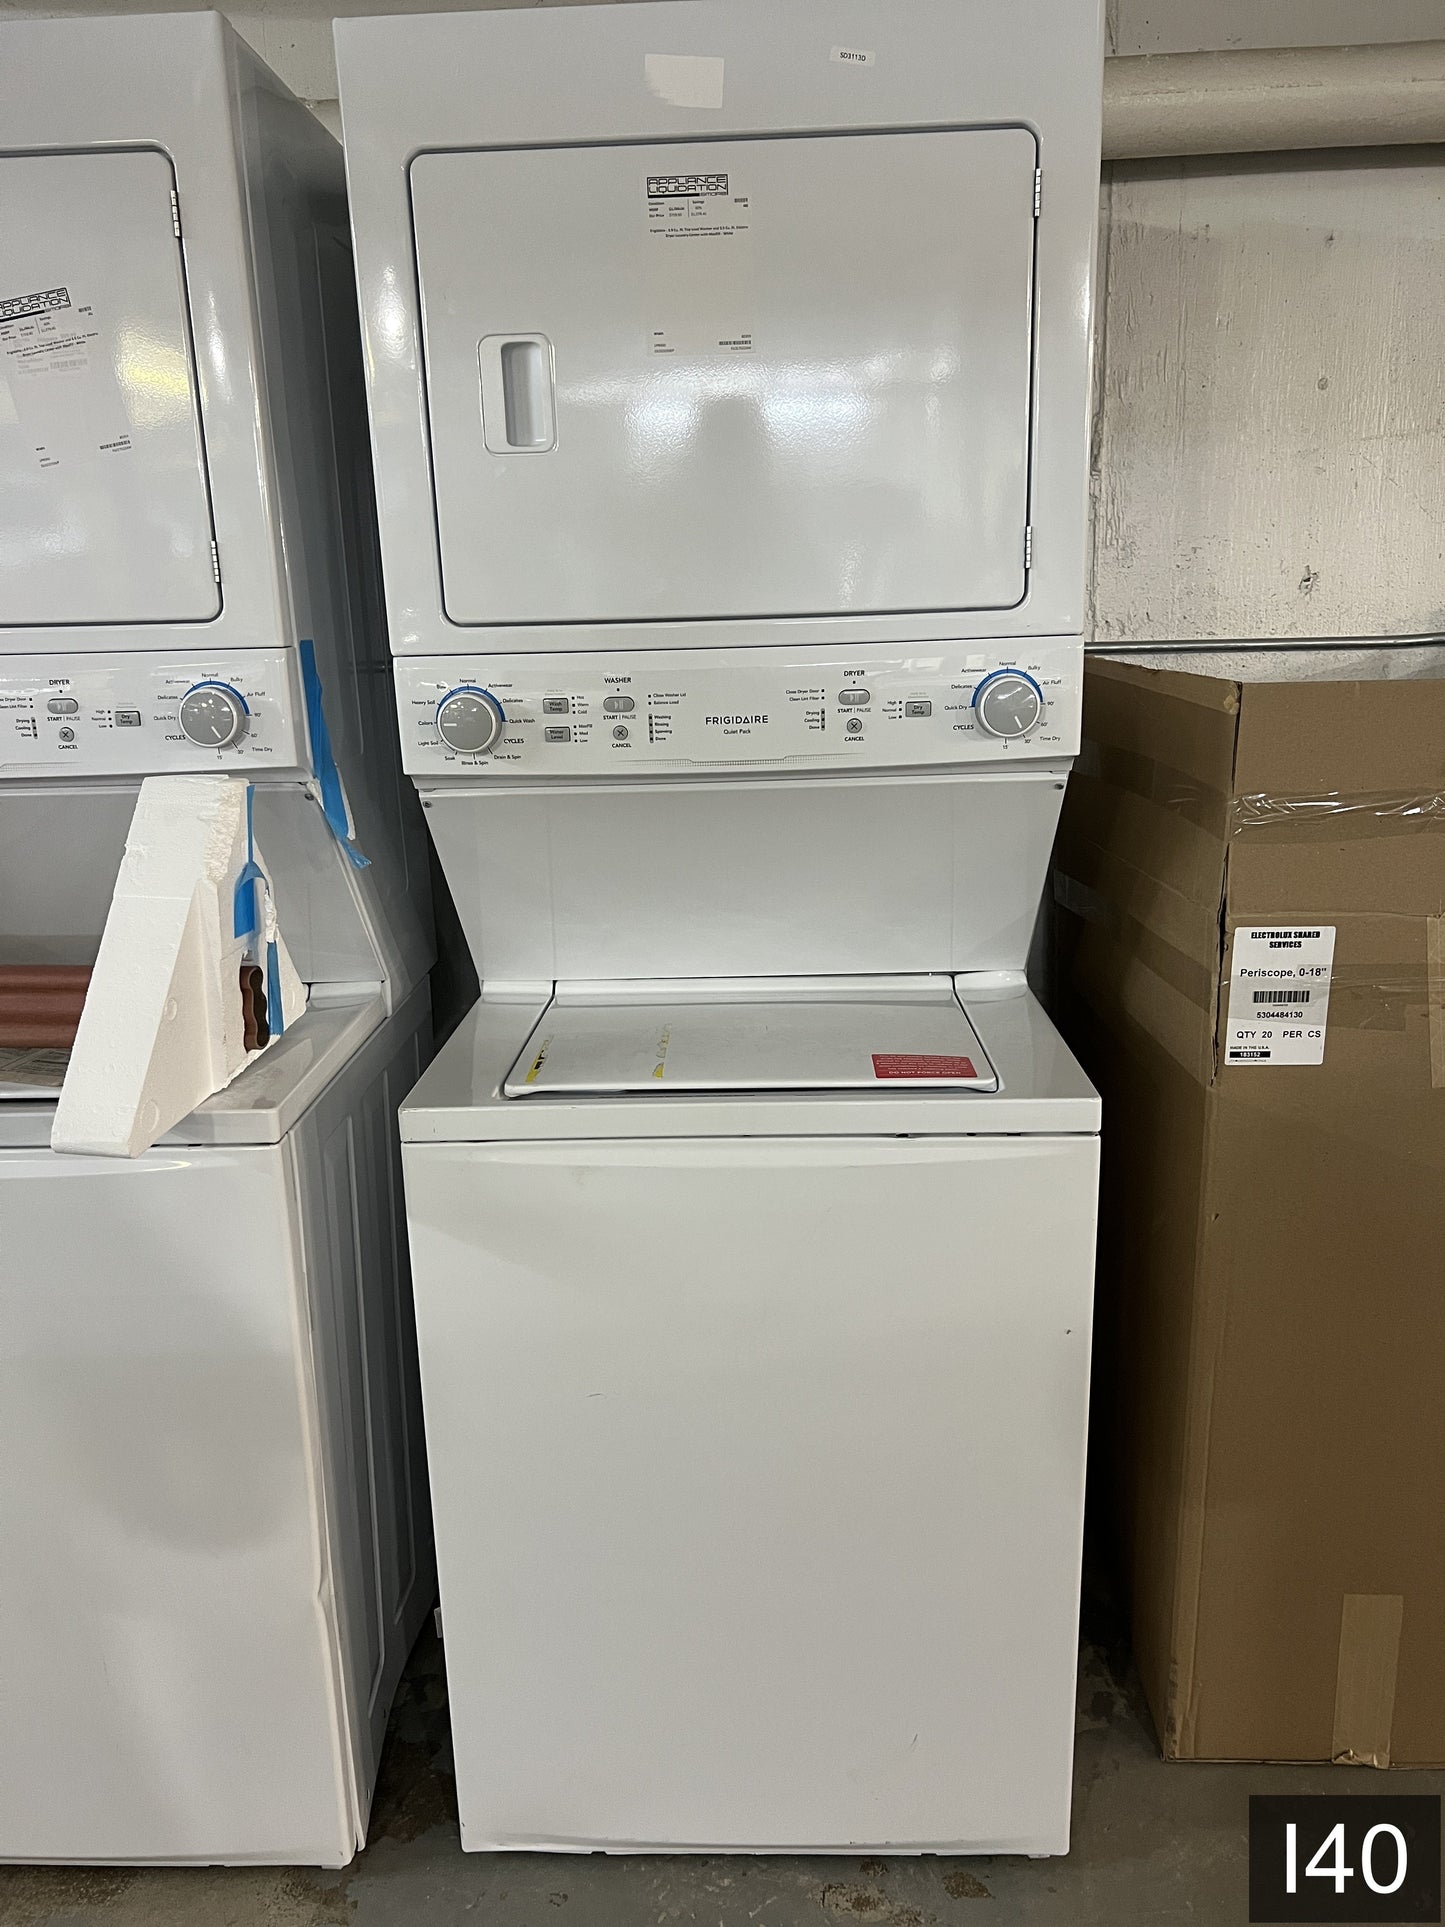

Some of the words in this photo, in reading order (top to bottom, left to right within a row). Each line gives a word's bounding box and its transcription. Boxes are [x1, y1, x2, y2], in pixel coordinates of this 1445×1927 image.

[649, 176, 726, 186] APPLIANCE
[649, 184, 726, 193] LIQUIDATION
[0, 290, 65, 308] PPLIANCE
[705, 714, 769, 725] FRIGIDAIRE
[1251, 931, 1292, 939] ELECTROLUX
[1293, 931, 1321, 939] SHARED
[1240, 968, 1296, 978] Periscope,
[1298, 967, 1327, 977] 0-18"
[1256, 1011, 1304, 1019] 5304484130
[1236, 1031, 1257, 1039] QTY
[1262, 1031, 1273, 1039] 20
[1282, 1030, 1303, 1038] PER
[1307, 1030, 1321, 1038] CS
